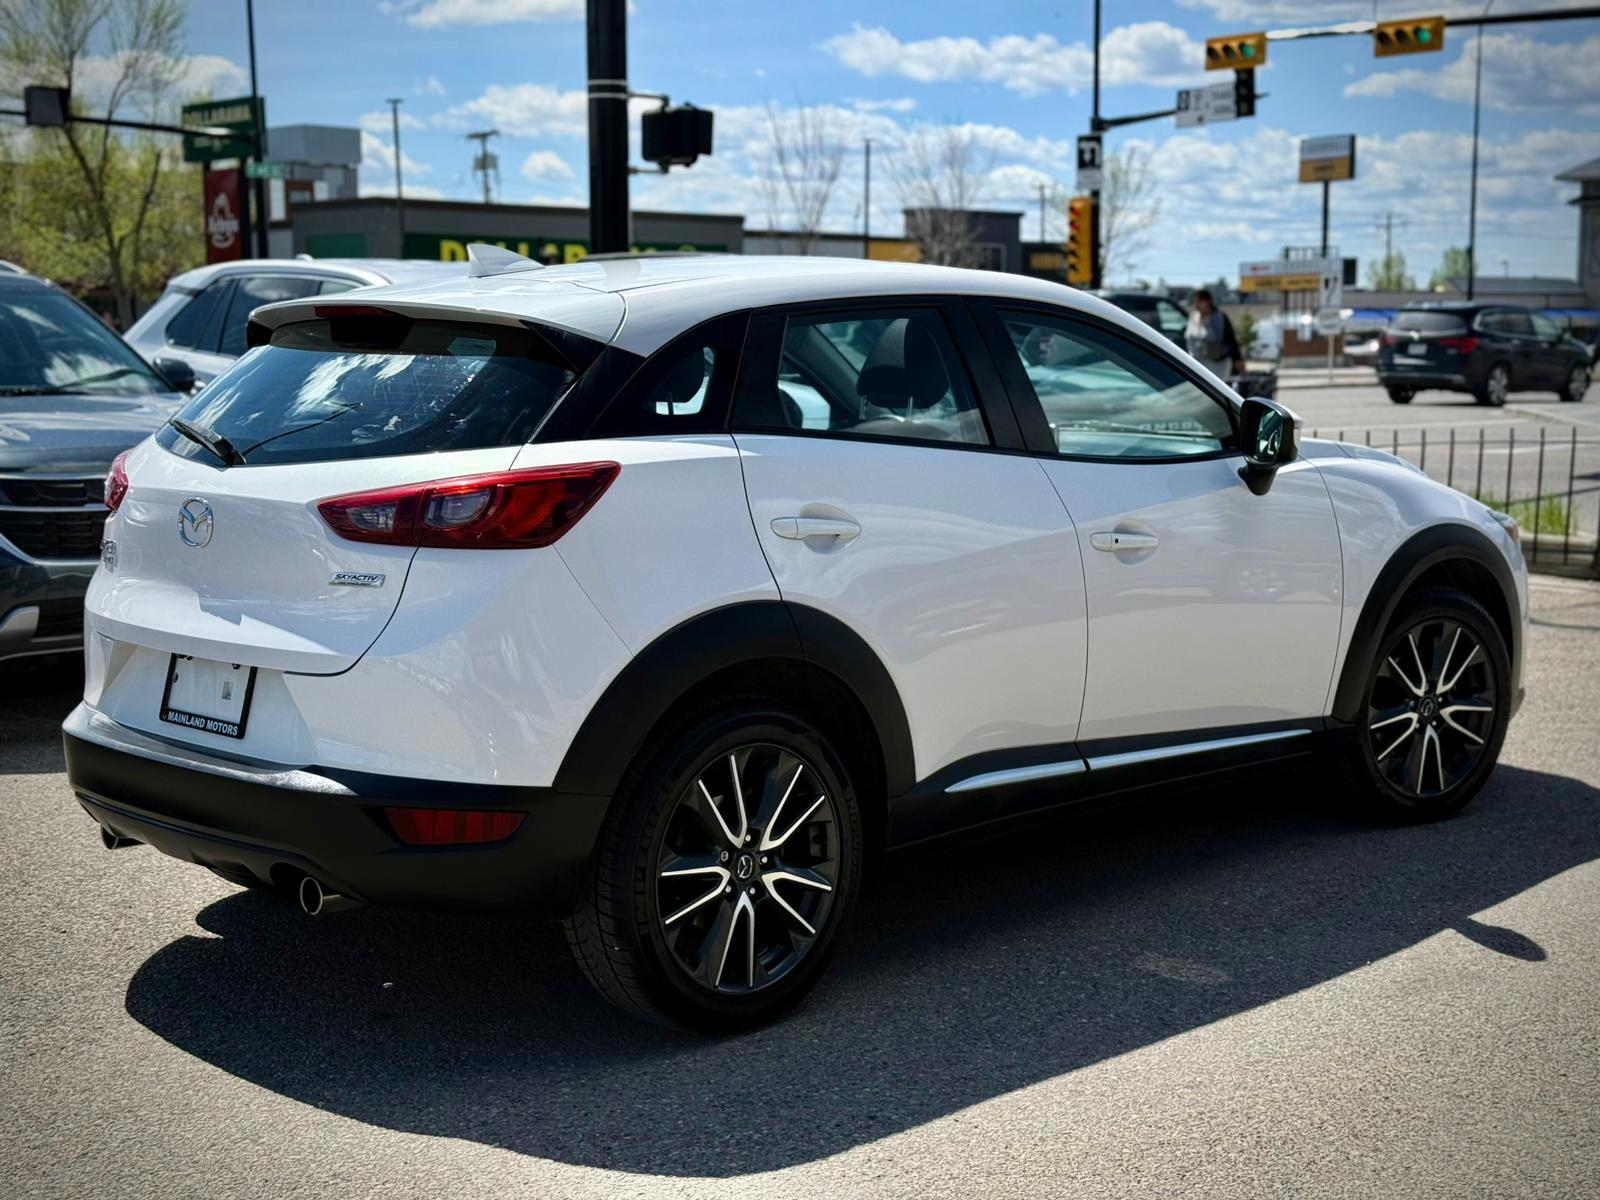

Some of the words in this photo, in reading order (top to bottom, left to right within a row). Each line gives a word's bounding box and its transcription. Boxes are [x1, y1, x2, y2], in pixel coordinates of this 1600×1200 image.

[334, 573, 379, 581] SKYACTIV
[167, 711, 205, 728] MAINLAND
[206, 719, 239, 736] MOTORS
